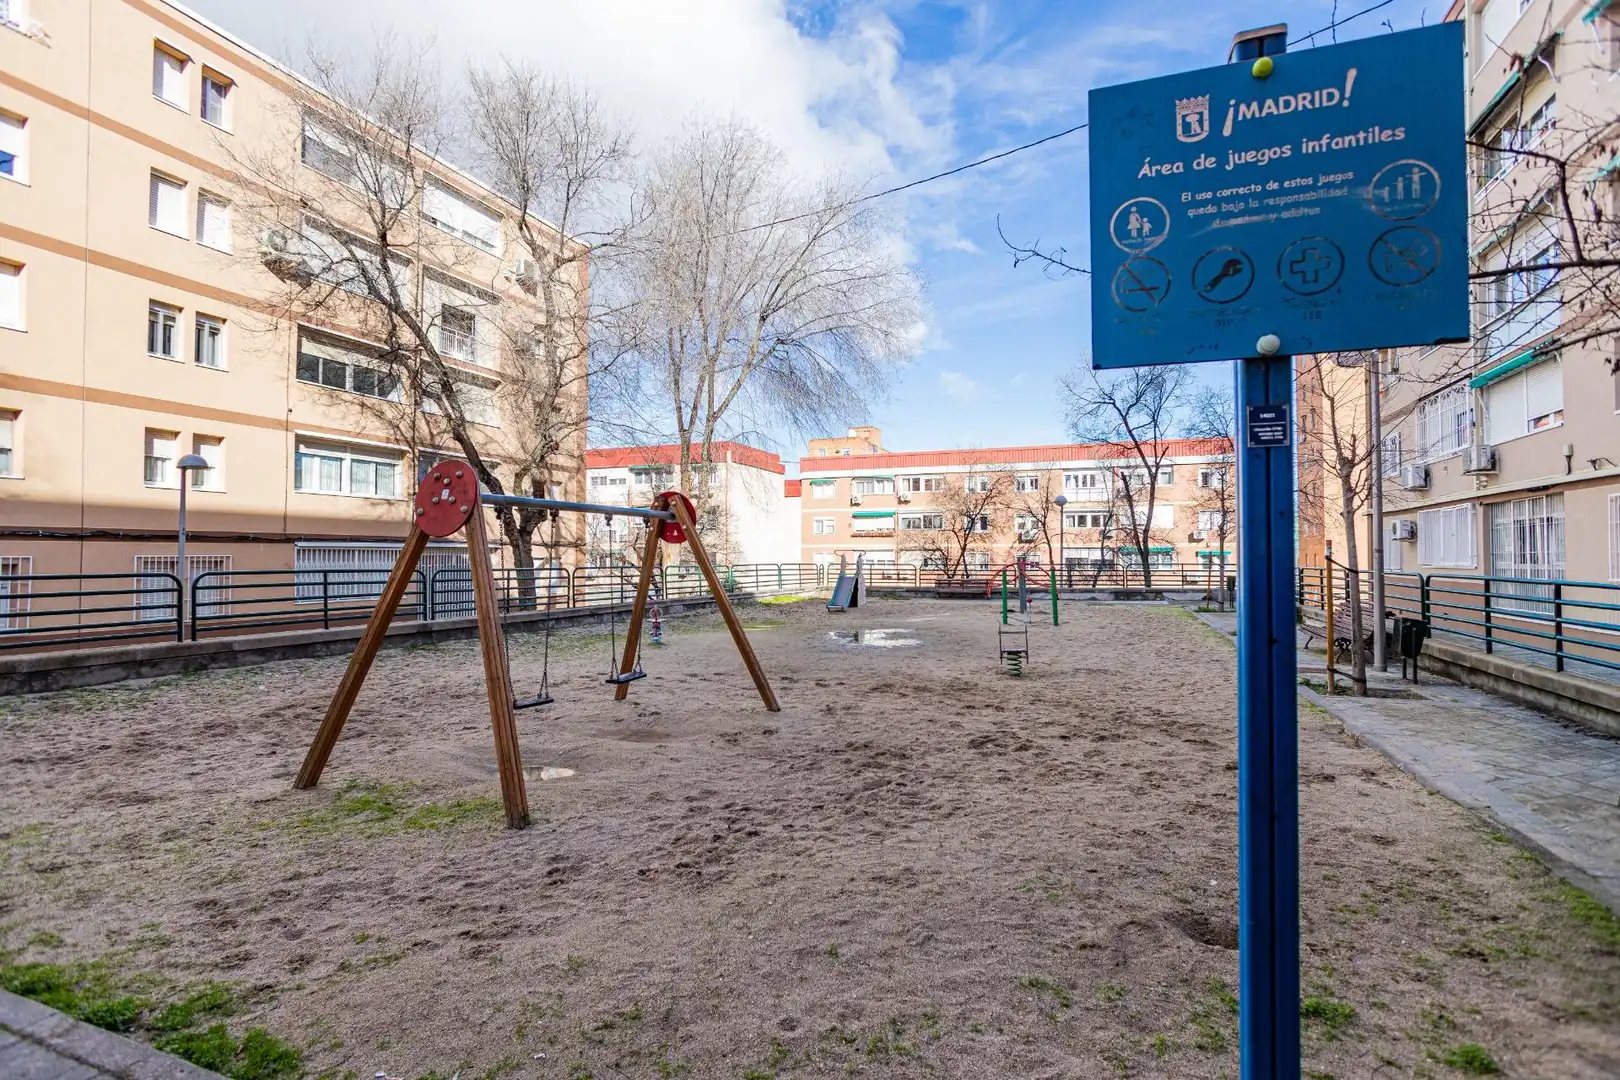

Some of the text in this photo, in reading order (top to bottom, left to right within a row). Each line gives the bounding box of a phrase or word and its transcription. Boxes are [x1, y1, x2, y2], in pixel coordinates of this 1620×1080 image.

[1222, 68, 1358, 137] ¡MADRID!
[1137, 126, 1406, 179] Área de juegos infantiles
[1181, 171, 1354, 203] El uso correcto de estos juegos
[1187, 186, 1348, 219] queda bajo la responsabilidad
